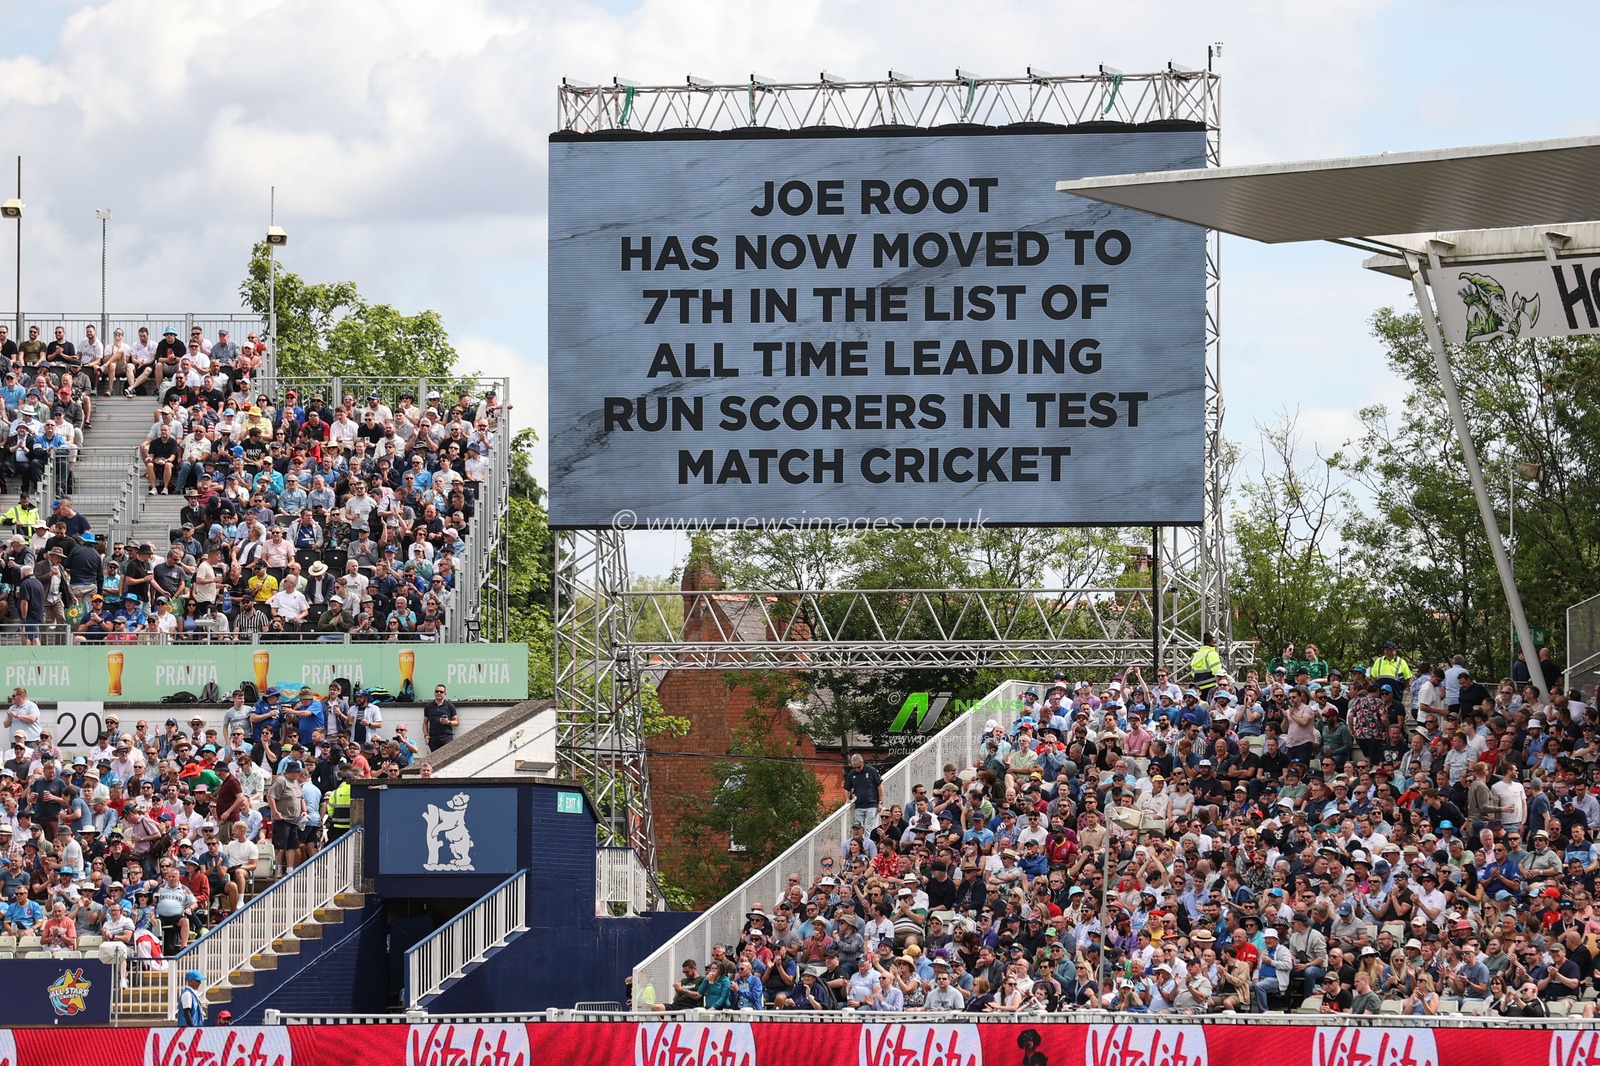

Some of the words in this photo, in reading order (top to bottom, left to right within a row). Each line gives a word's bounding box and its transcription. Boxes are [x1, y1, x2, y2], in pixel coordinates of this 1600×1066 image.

[750, 179, 844, 216] JOE
[861, 177, 998, 215] ROOT
[621, 235, 719, 271] HAS
[736, 233, 857, 270] NOW
[874, 231, 1050, 268] MOVED
[1065, 230, 1131, 266] TO
[643, 288, 732, 324] 7TH
[750, 287, 797, 323] IN
[813, 286, 908, 322] THE
[925, 285, 1026, 321] LIST
[1042, 284, 1109, 320] OF
[647, 343, 739, 378] ALL
[754, 341, 868, 377] TIME
[885, 339, 1102, 375] LEADING
[604, 397, 703, 431] RUN
[719, 394, 946, 431] SCORERS
[963, 394, 1010, 429] IN
[1027, 392, 1148, 428] TEST
[679, 448, 843, 484] MATCH
[861, 446, 1071, 484] CRICKET
[6, 665, 70, 686] PRAVHA
[156, 665, 218, 686] PRAVHA
[301, 664, 364, 685] PRAVHA
[447, 663, 510, 684] PRAVHA
[57, 712, 102, 747] 20
[52, 989, 64, 997] ALL
[65, 986, 89, 997] STARS
